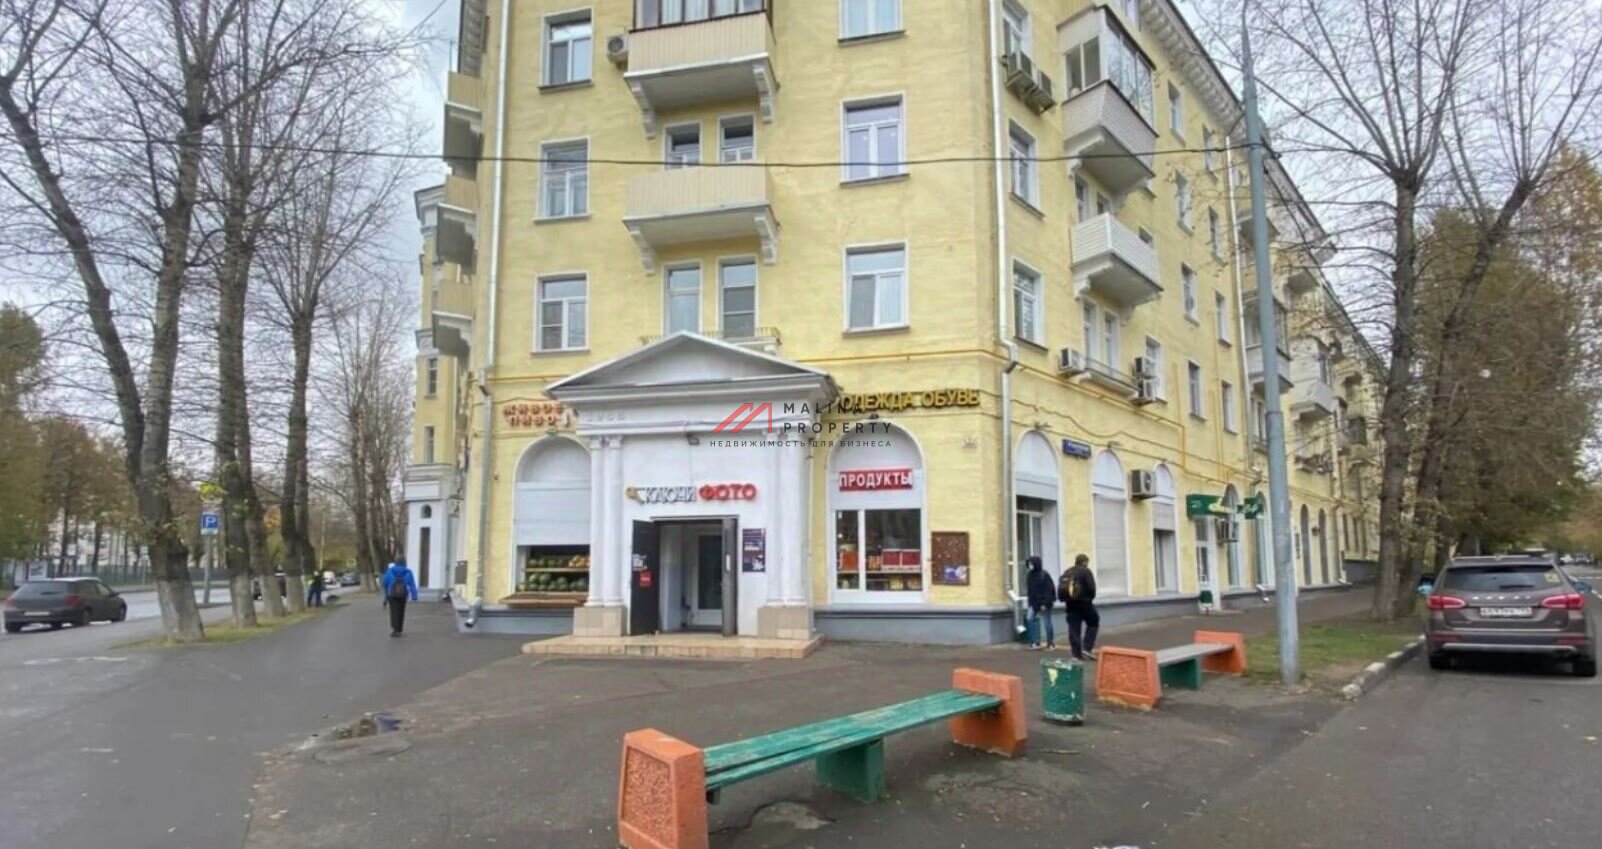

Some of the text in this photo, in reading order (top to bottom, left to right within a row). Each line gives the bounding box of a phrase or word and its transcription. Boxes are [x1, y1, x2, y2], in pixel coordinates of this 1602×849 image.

[841, 388, 980, 412] ОДЕЖДА ОБУВЬ
[503, 403, 564, 417] ЖИВОЕ
[509, 415, 557, 427] ПИВО
[840, 471, 913, 489] ПРОДУКТЫ
[645, 483, 757, 503] КЛЮЧИ ФОТО
